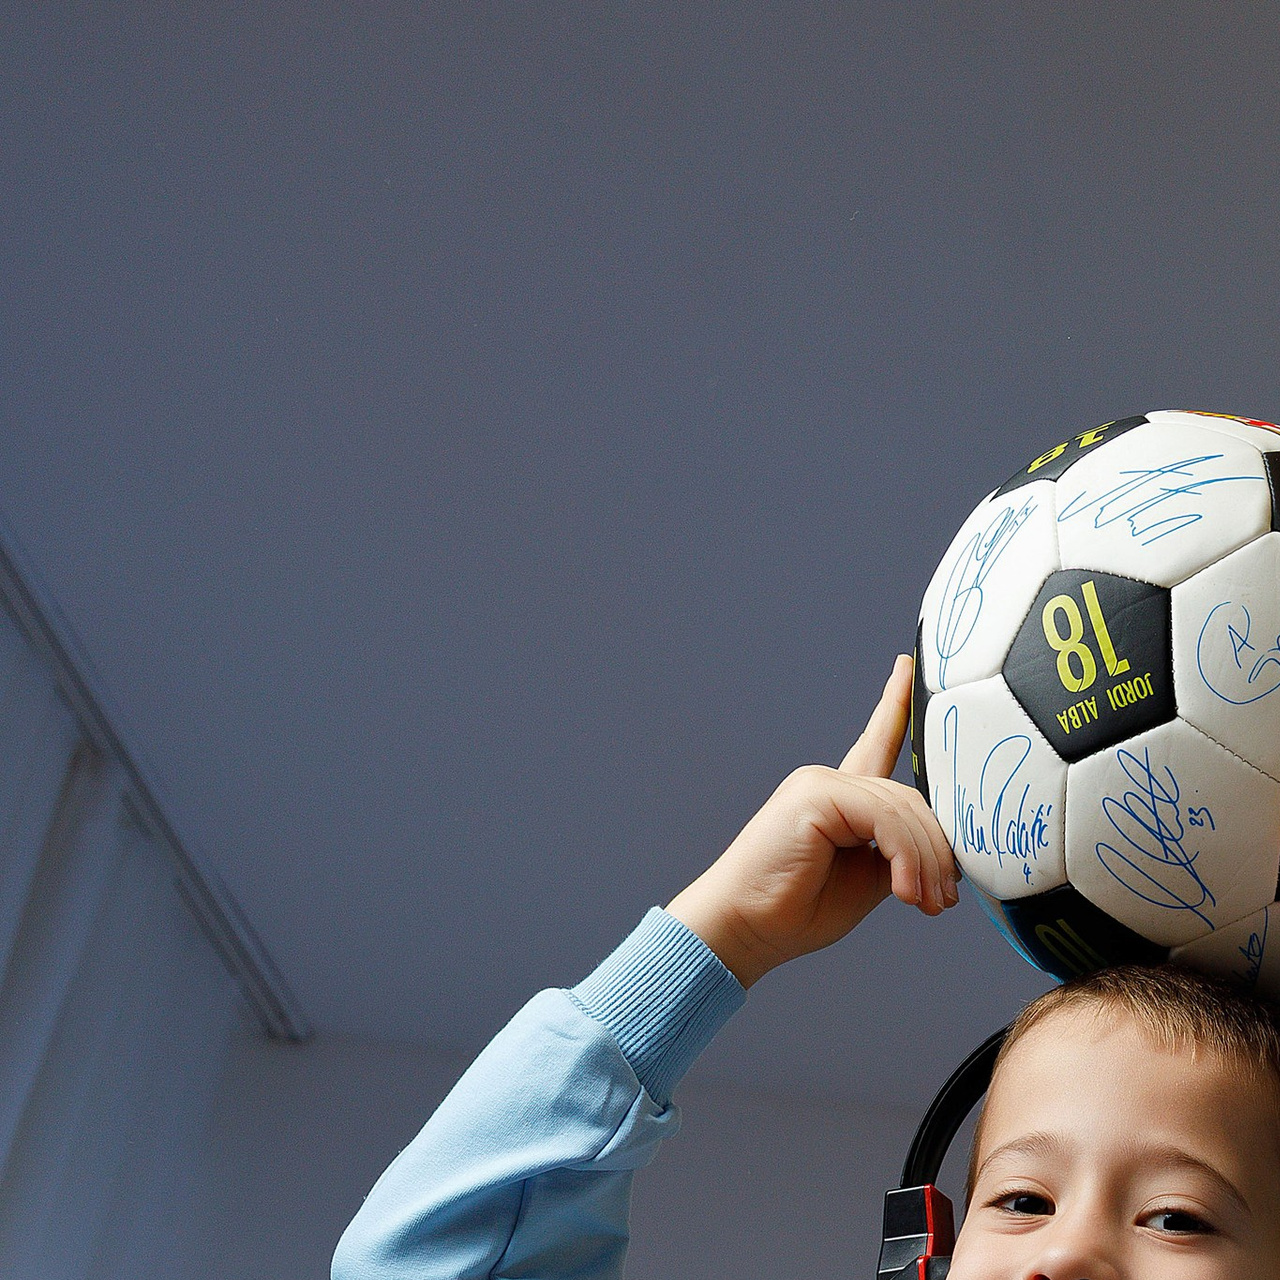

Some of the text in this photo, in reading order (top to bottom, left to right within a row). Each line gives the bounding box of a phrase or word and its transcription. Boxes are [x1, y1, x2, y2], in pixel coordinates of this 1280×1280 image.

[1041, 580, 1131, 693] 18
[1055, 672, 1154, 735] JORDI ALBA
